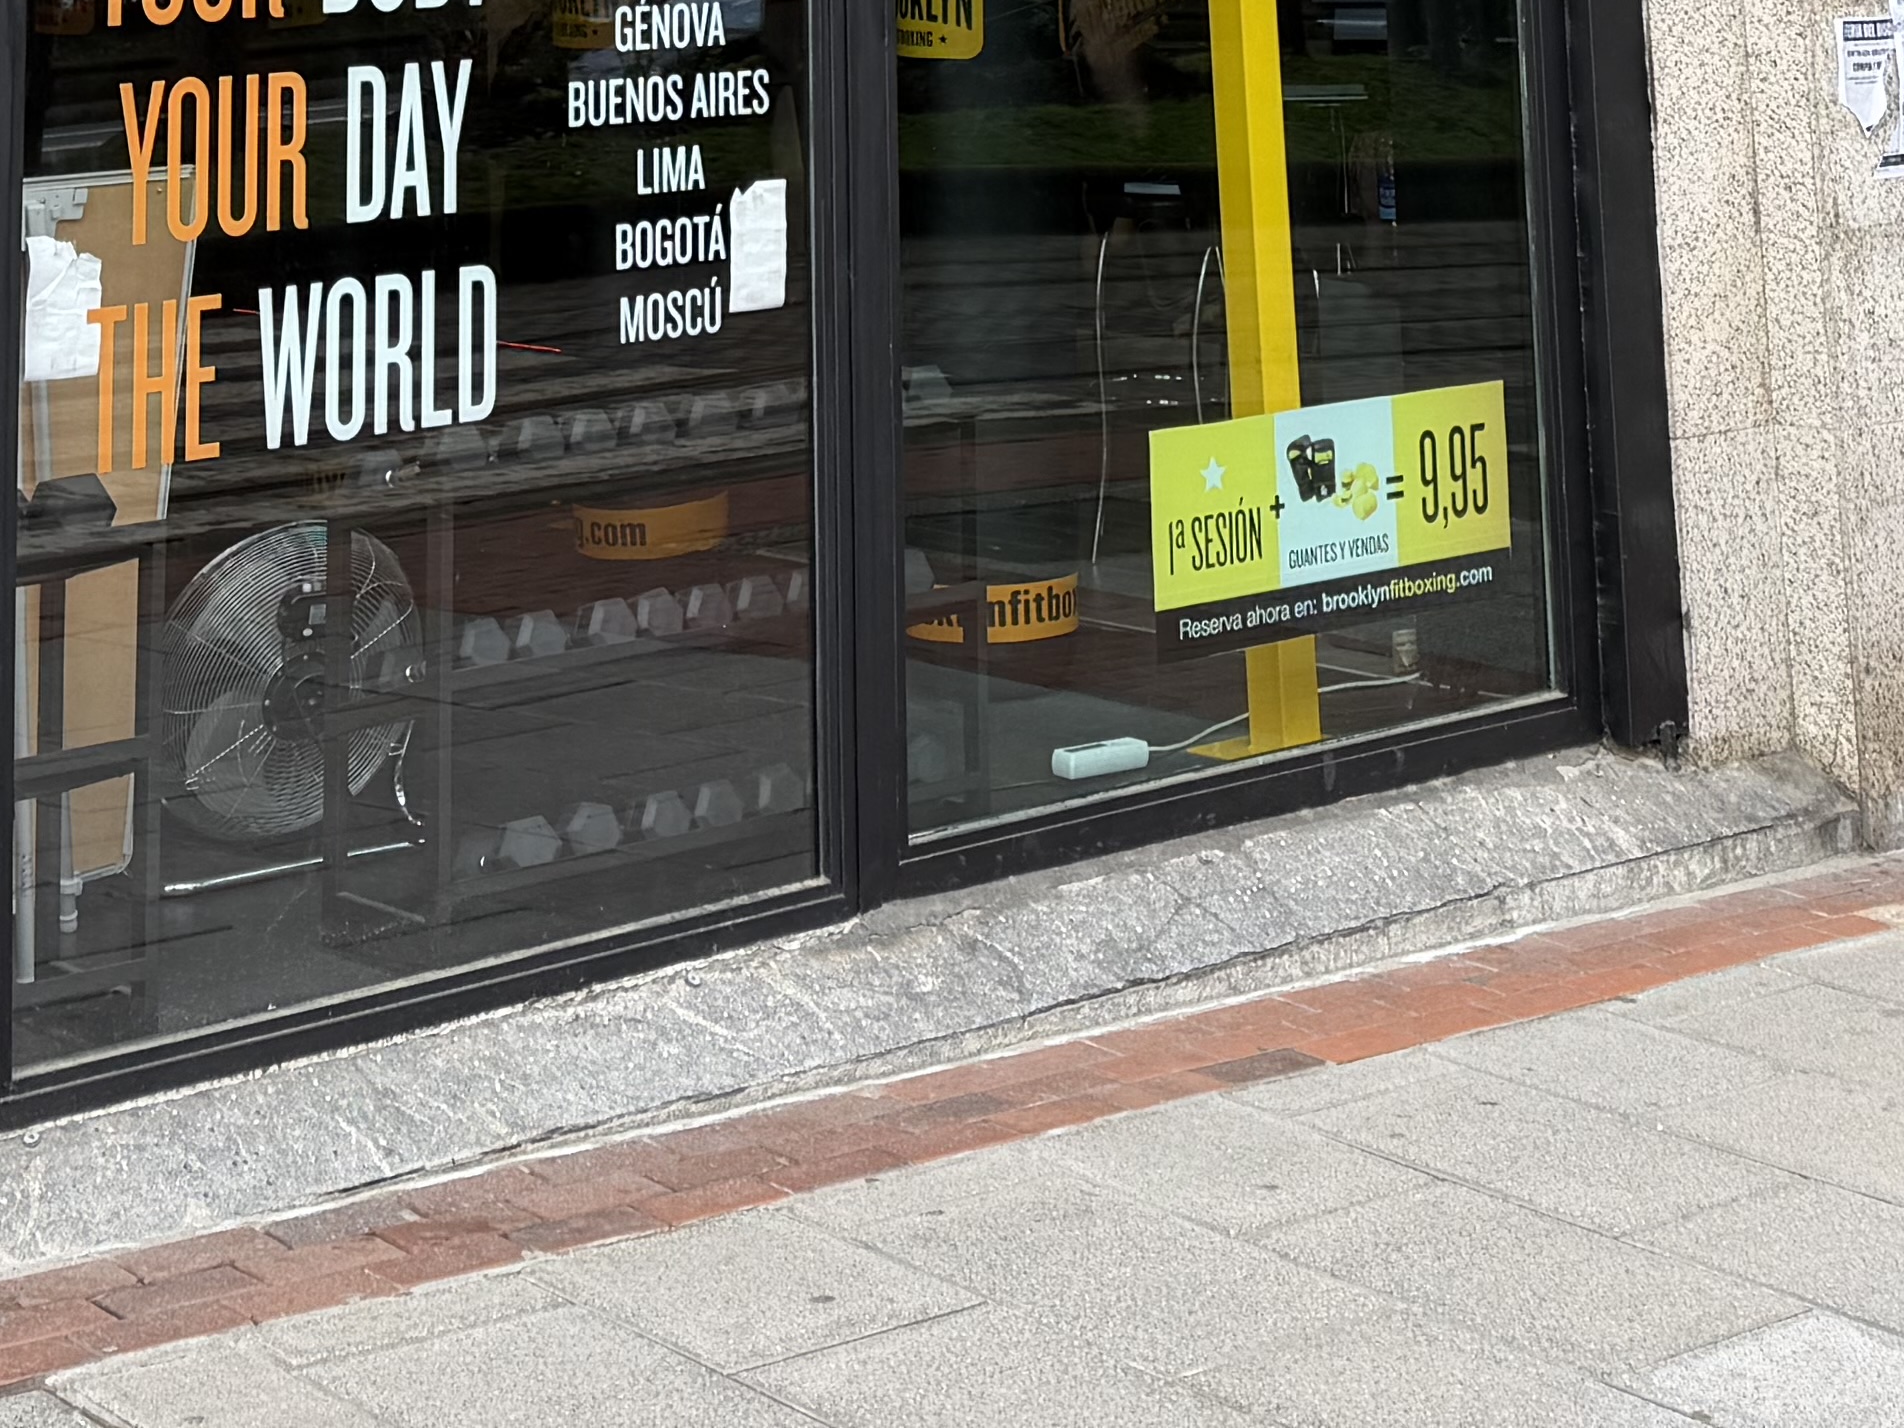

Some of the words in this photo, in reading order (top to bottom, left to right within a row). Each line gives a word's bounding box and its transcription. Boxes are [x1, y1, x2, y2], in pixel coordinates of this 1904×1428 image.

[568, 76, 683, 128] BUENOS
[690, 68, 770, 119] AIRES
[121, 72, 309, 246] YOUR
[346, 58, 473, 224] DAY
[637, 144, 705, 195] LIMA
[615, 204, 726, 271] BOGOTÁ
[619, 281, 724, 345] MOSCÚ
[88, 293, 222, 476] THE
[258, 264, 497, 450] WORLD
[1191, 497, 1263, 572] SESIÓN
[1418, 422, 1489, 530] 9,95
[1288, 541, 1338, 570] GUANTES
[1339, 541, 1348, 561] Y
[1348, 533, 1390, 560] VENDAS
[1179, 612, 1243, 641] Reserva
[1246, 602, 1291, 628] ahora
[1294, 599, 1318, 618] en:
[1321, 564, 1493, 614] brooklynfitboxing.com
